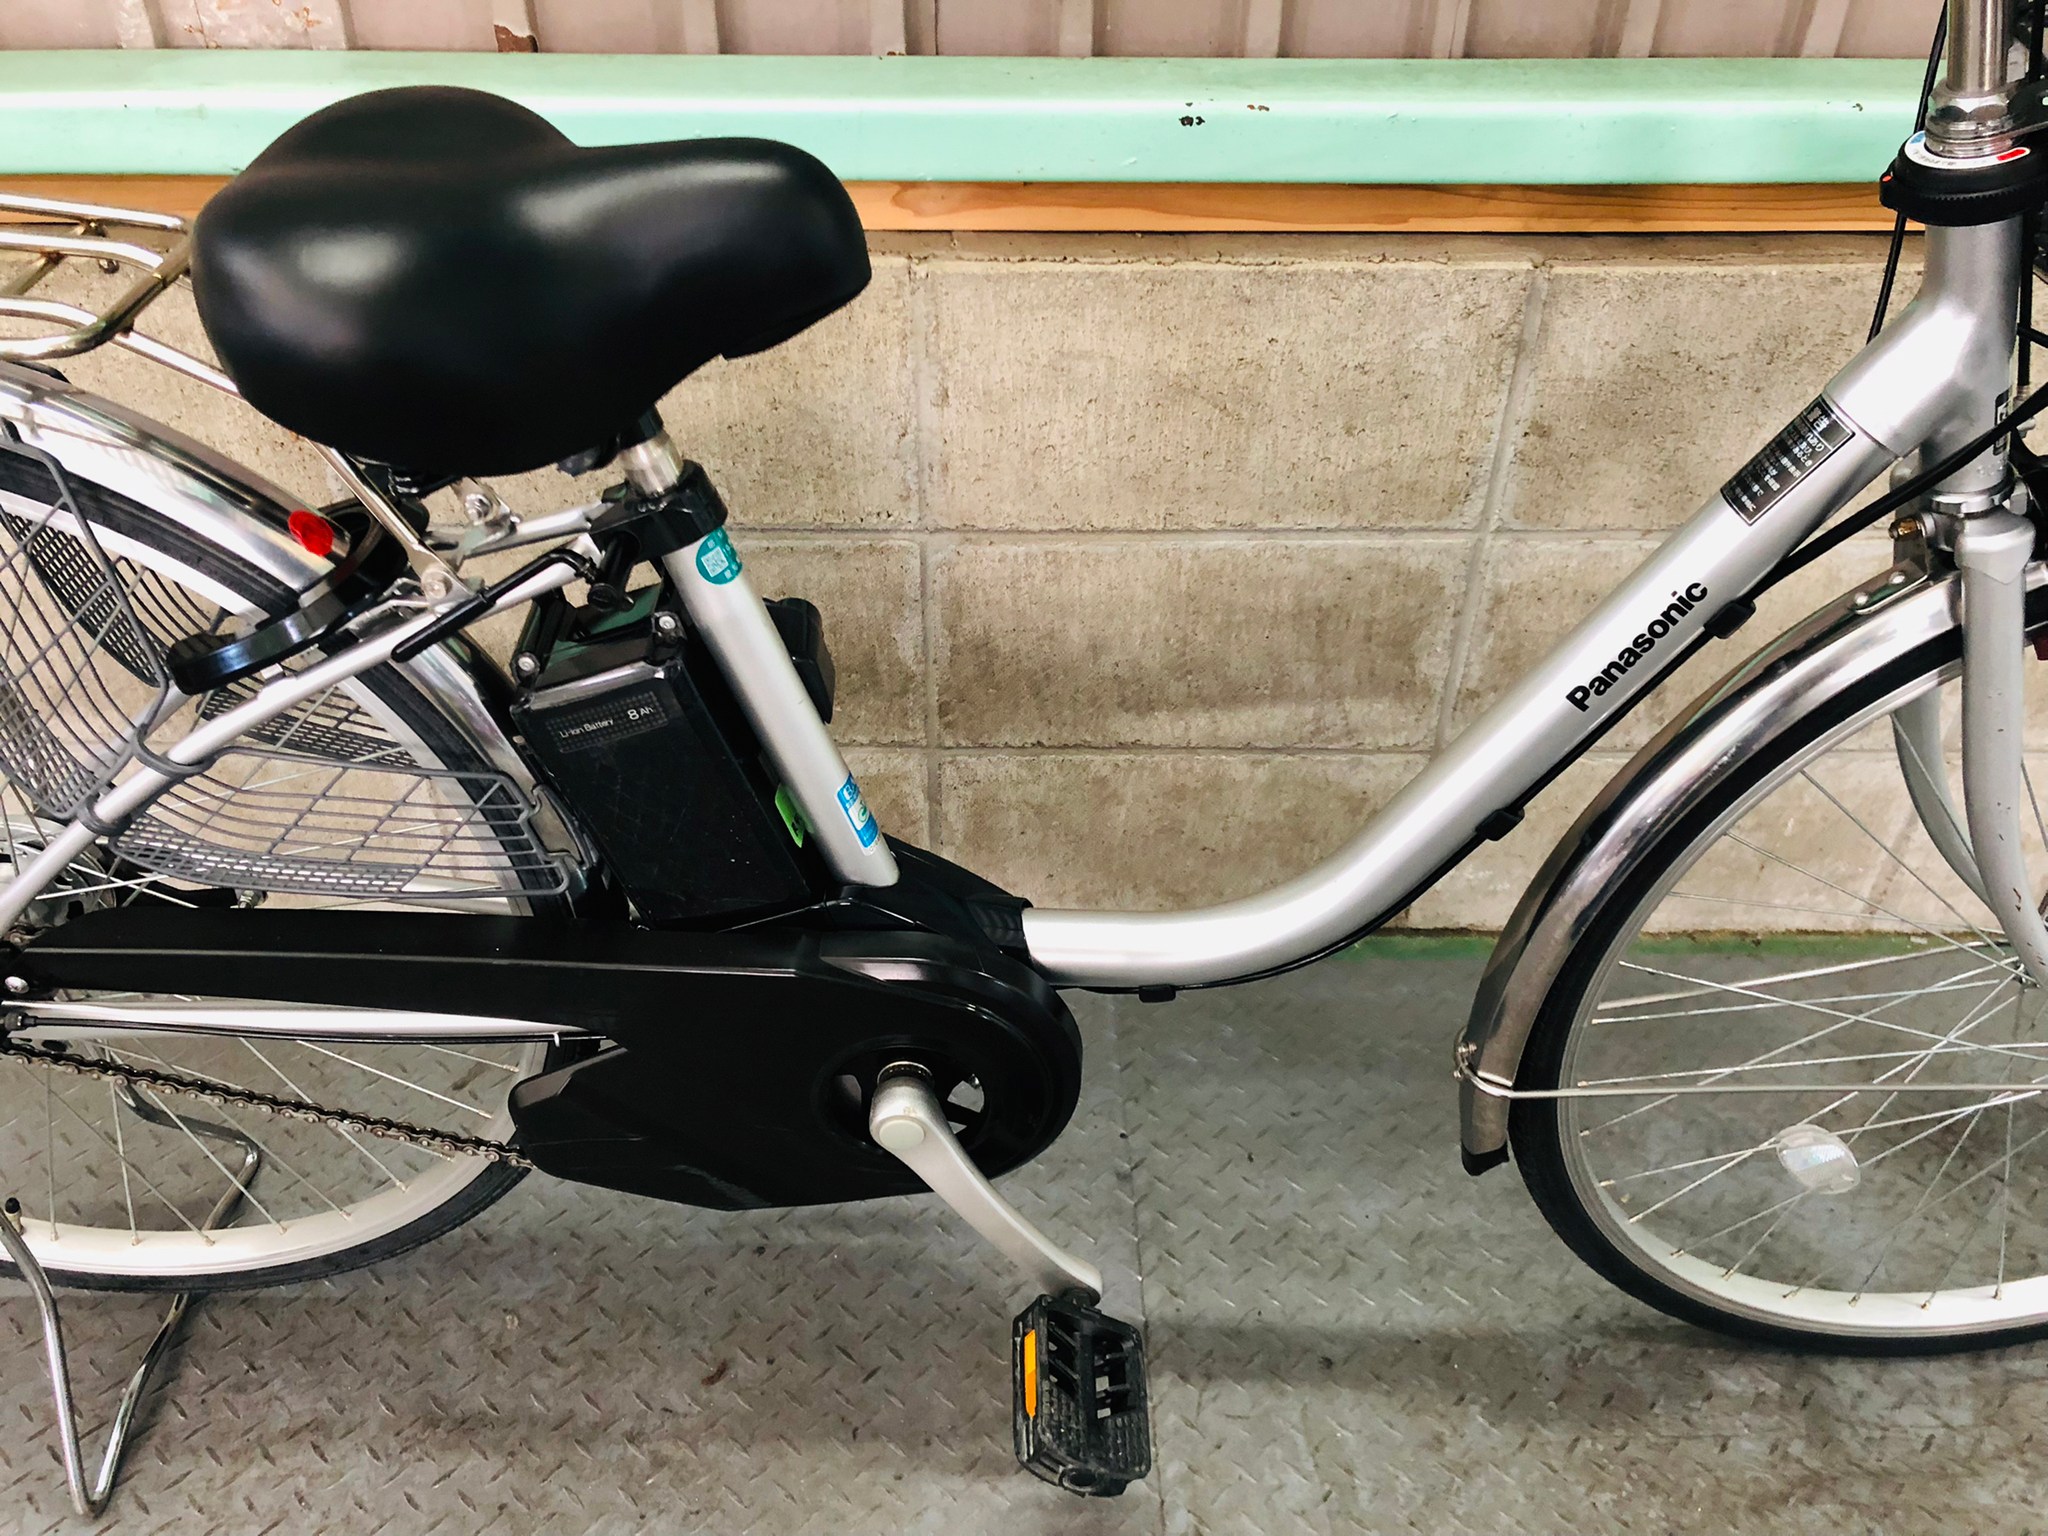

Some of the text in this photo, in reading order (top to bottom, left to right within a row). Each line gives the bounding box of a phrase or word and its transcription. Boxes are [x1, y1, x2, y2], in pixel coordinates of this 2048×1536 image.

[1565, 582, 1708, 712] Panasonic
[583, 718, 614, 732] Battery
[627, 708, 639, 721] 8
[639, 706, 654, 717] Ah
